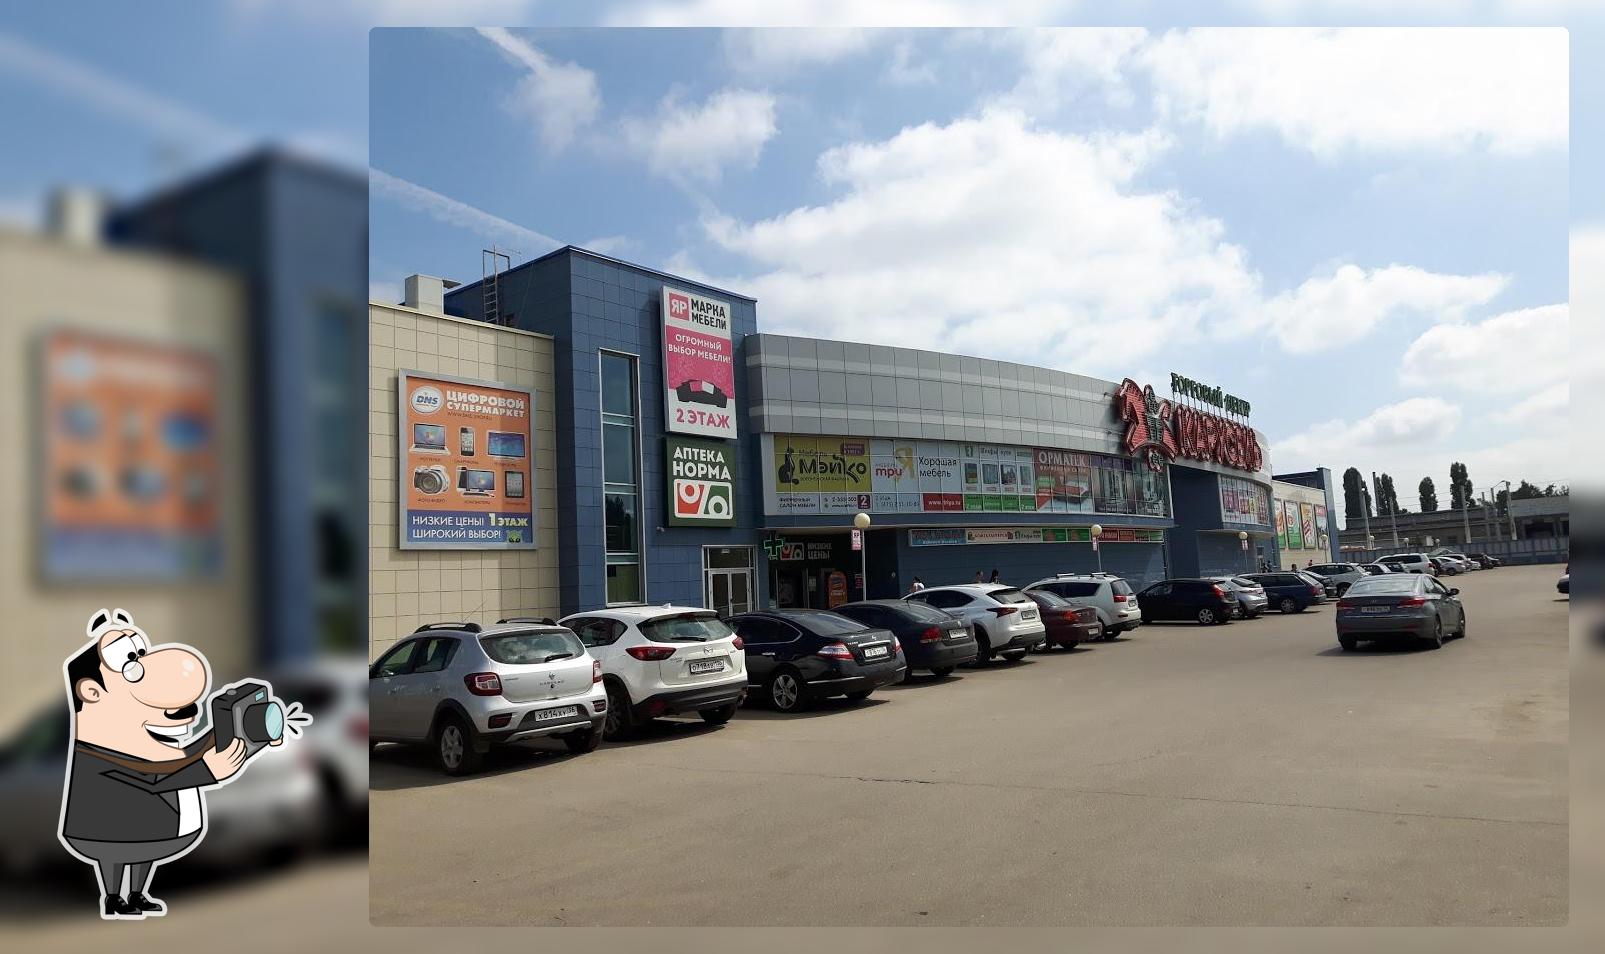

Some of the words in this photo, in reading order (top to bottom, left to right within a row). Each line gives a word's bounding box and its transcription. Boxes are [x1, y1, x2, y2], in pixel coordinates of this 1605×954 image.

[671, 298, 688, 315] ЯР
[690, 297, 726, 319] МАРКА
[691, 312, 727, 330] МЕБЕЛИ
[675, 333, 722, 350] ОГРОМНЫЙ
[668, 343, 697, 356] ВЫБОР
[697, 350, 731, 364] МЕБЕЛИ!
[415, 394, 439, 405] DNS
[446, 389, 525, 410] ЦИФРОВОЙ
[446, 401, 526, 418] СУПЕРМАРКЕТ
[676, 408, 685, 424] 2
[687, 409, 730, 429] ЭТАЖ
[673, 446, 725, 463] АПТЕКА
[918, 456, 957, 467] Хорошая
[672, 460, 732, 480] НОРМА
[919, 468, 952, 479] мебель
[860, 495, 868, 506] 2
[412, 515, 454, 527] НИЗКИЕ
[455, 516, 485, 528] ЦЕНЫ!
[488, 512, 496, 527] 1
[497, 517, 529, 527] ЭТАЖ
[412, 526, 466, 539] ШИРОКИЙ
[468, 529, 501, 539] ВЫБОР!
